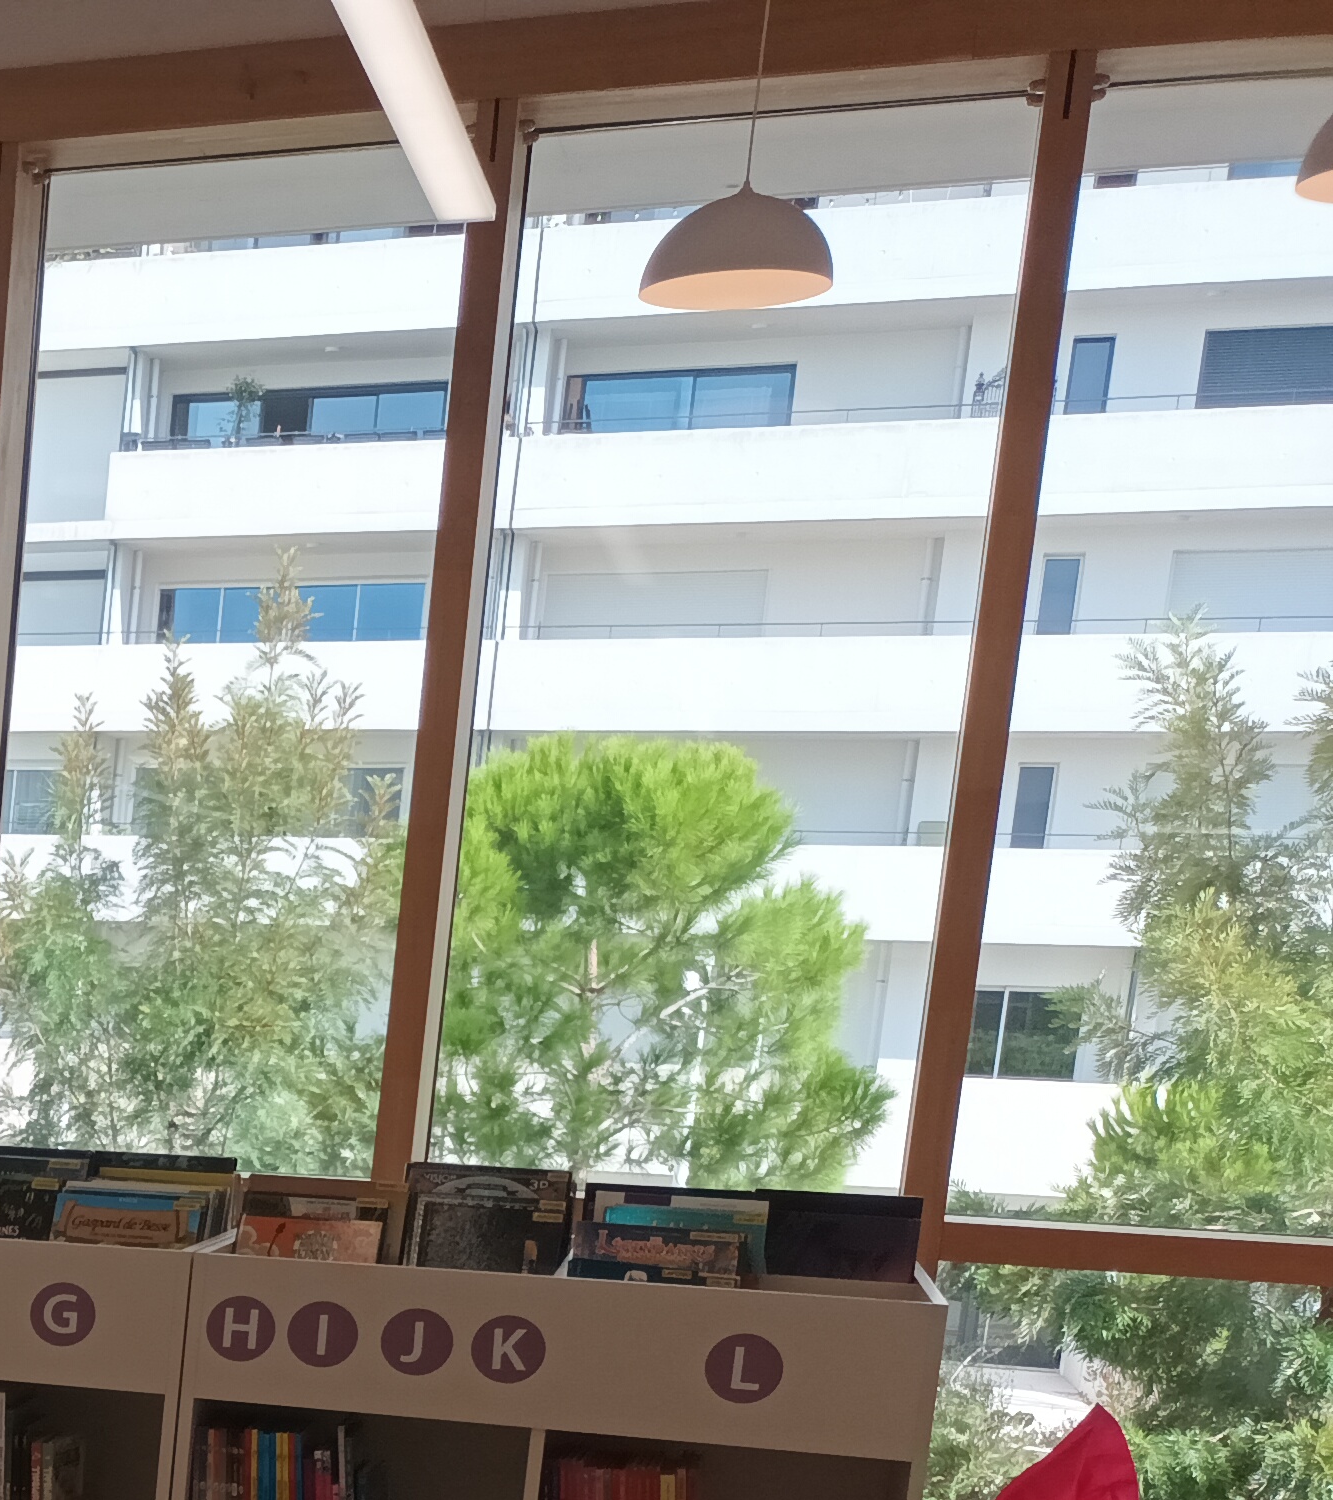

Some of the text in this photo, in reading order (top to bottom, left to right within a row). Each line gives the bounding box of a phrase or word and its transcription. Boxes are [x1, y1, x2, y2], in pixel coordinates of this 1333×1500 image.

[43, 1293, 78, 1334] G
[222, 1307, 259, 1350] H
[316, 1314, 329, 1356] I
[399, 1321, 425, 1363] J
[491, 1328, 528, 1371] K
[730, 1346, 760, 1391] L
